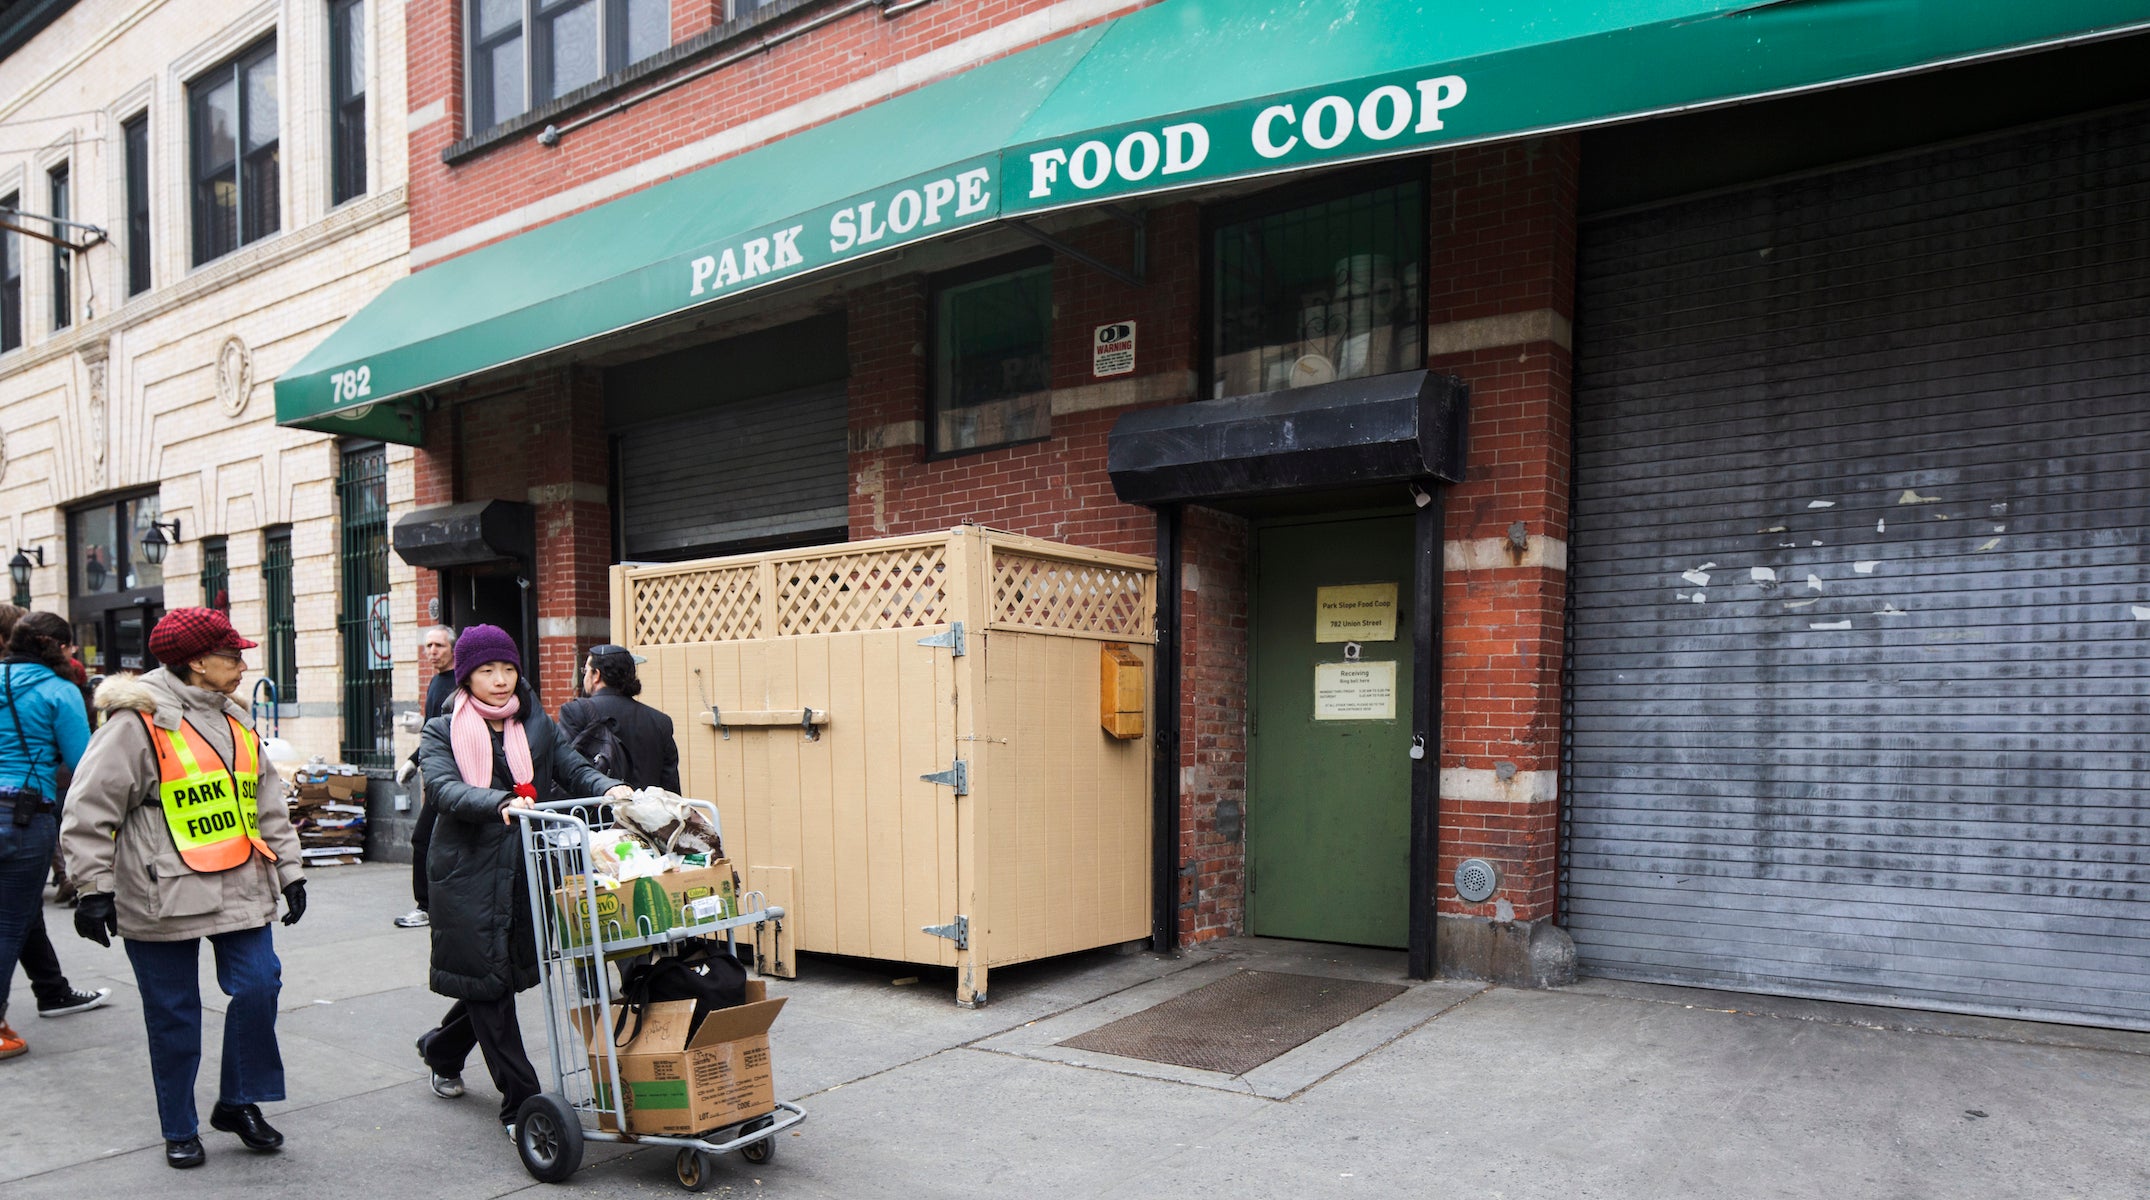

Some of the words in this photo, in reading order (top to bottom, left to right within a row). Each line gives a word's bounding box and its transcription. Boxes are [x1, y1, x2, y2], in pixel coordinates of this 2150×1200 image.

[690, 225, 803, 297] PARK
[829, 167, 991, 253] SLOPE
[1029, 122, 1210, 199] FOOD
[1251, 74, 1468, 159] COOP
[1096, 340, 1132, 355] WARNING
[330, 365, 371, 404] 782
[1338, 601, 1356, 610] Slope
[1357, 600, 1373, 608] Food
[1374, 600, 1391, 608] Coop
[1362, 619, 1382, 627] Street
[173, 780, 226, 808] PARK
[242, 780, 258, 799] SLO
[186, 810, 236, 838] FOOD
